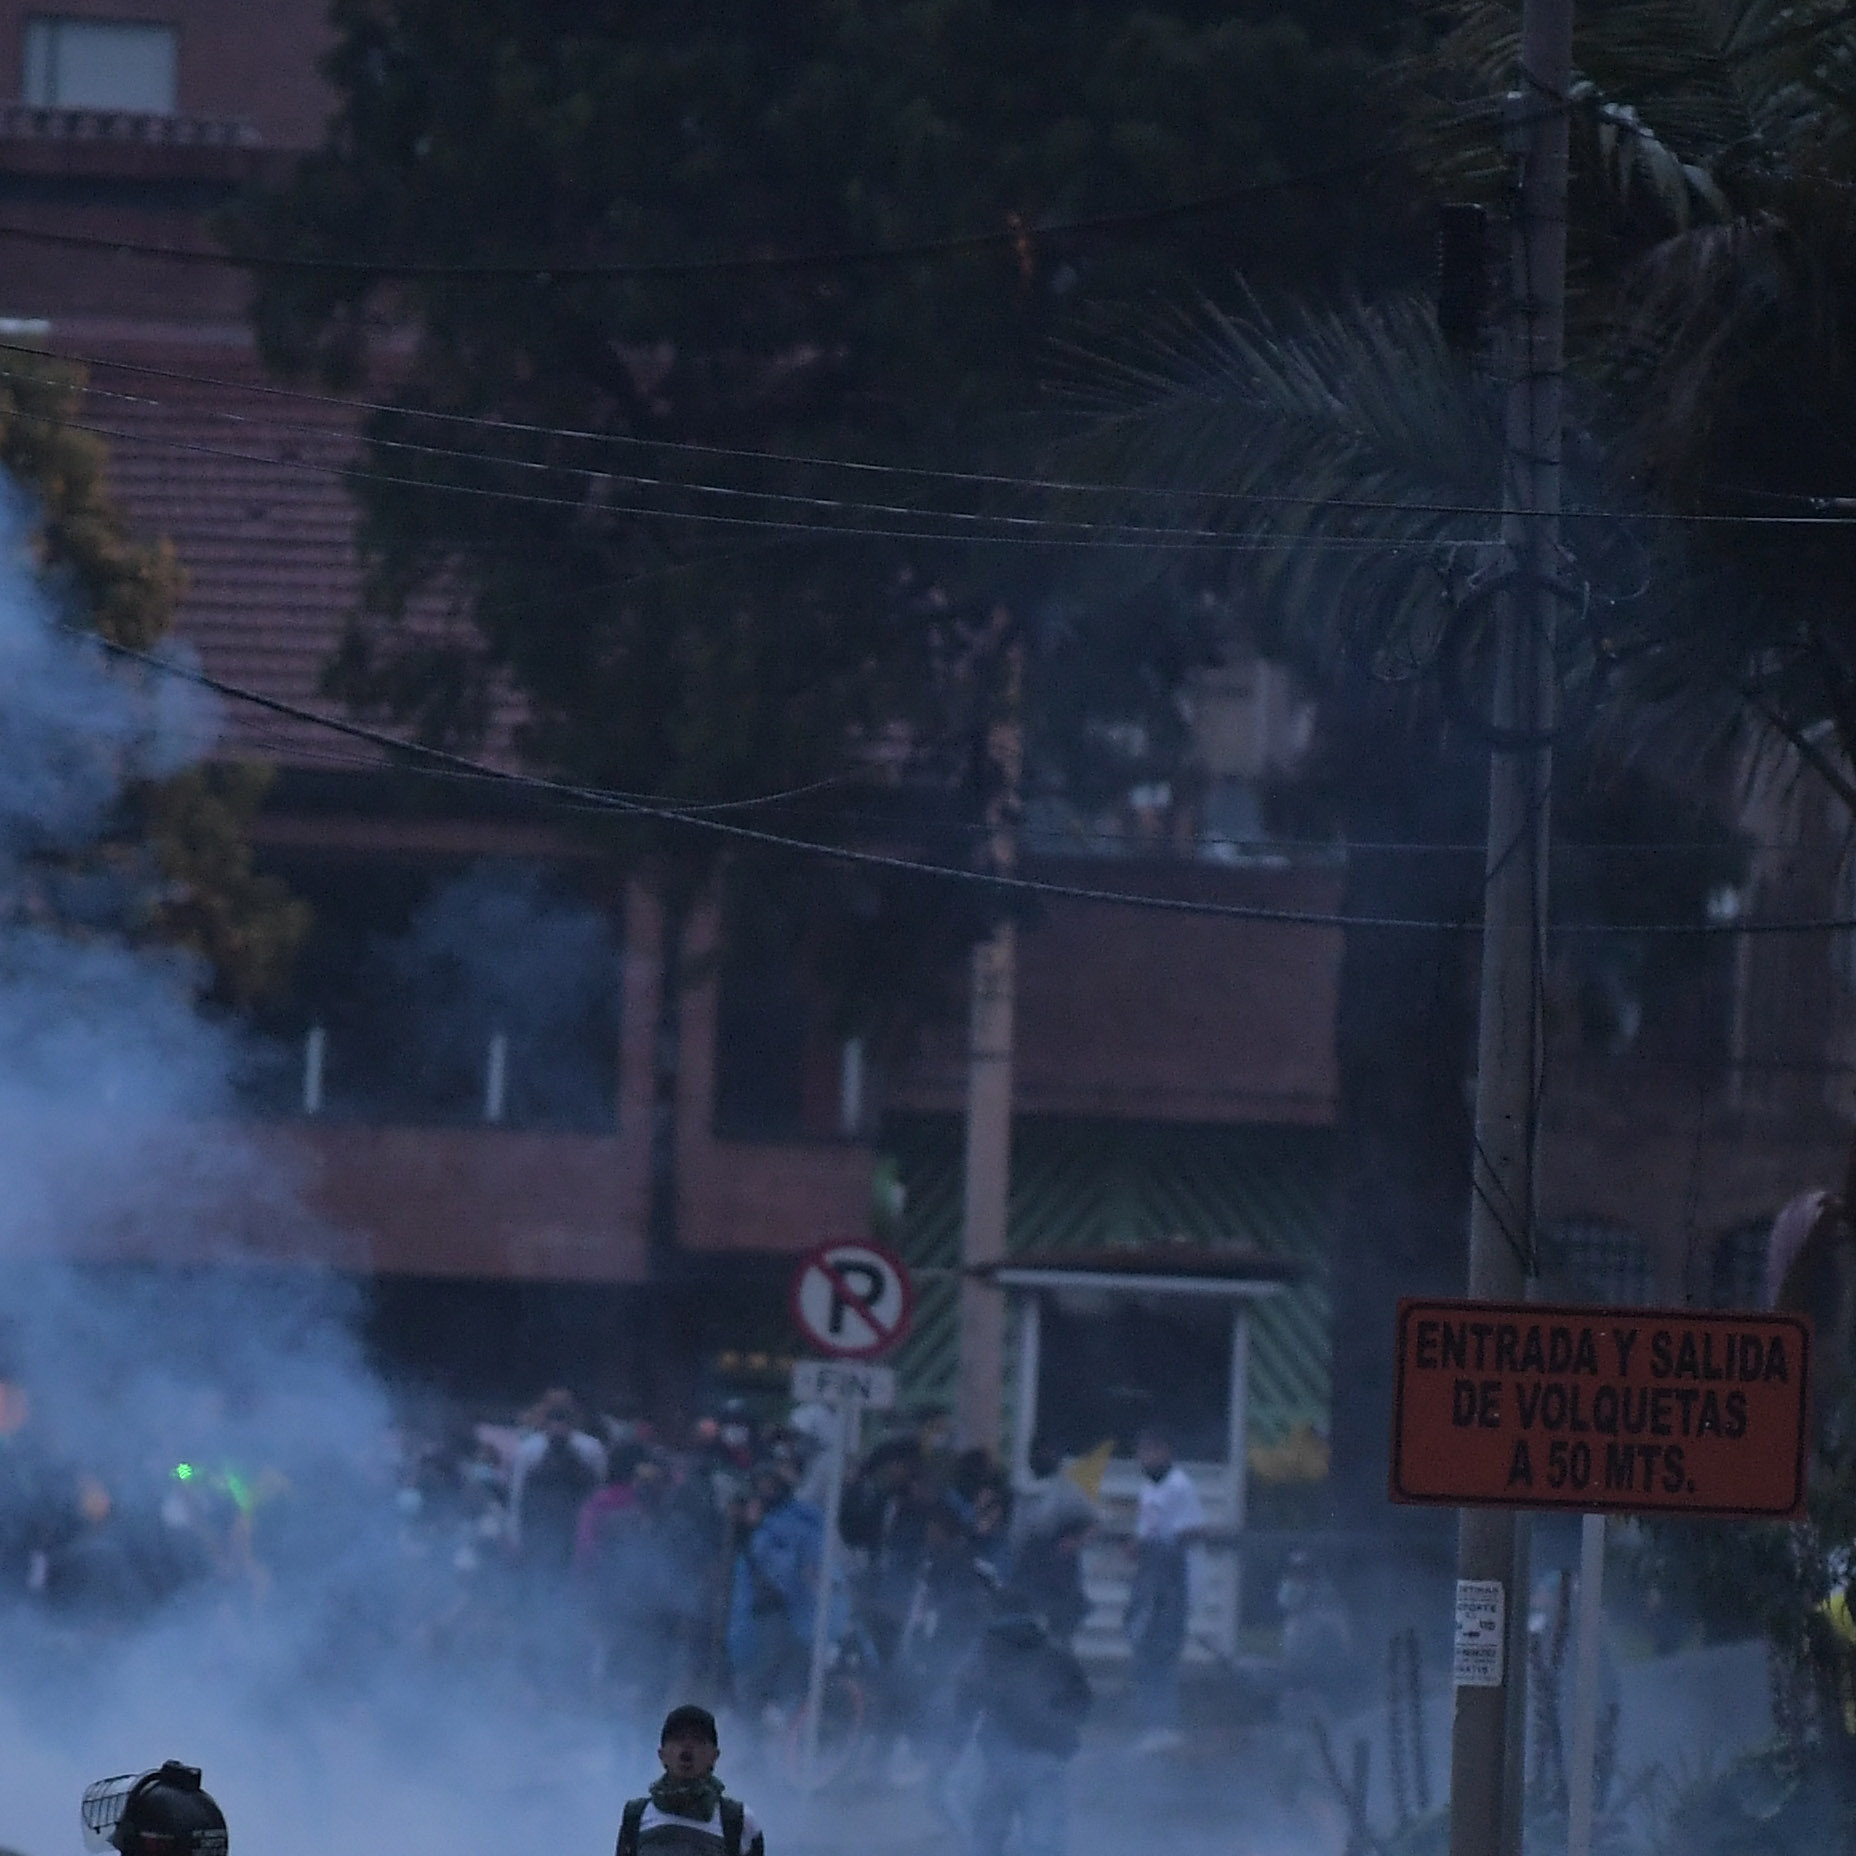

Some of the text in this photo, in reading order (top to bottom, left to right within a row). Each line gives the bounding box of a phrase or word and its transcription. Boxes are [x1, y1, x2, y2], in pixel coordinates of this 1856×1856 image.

[1416, 1320, 1789, 1383] ENTRADA Y SALIDA
[1451, 1379, 1748, 1440] DE VOLQUETAS
[1504, 1439, 1697, 1495] A 50 MTS.
